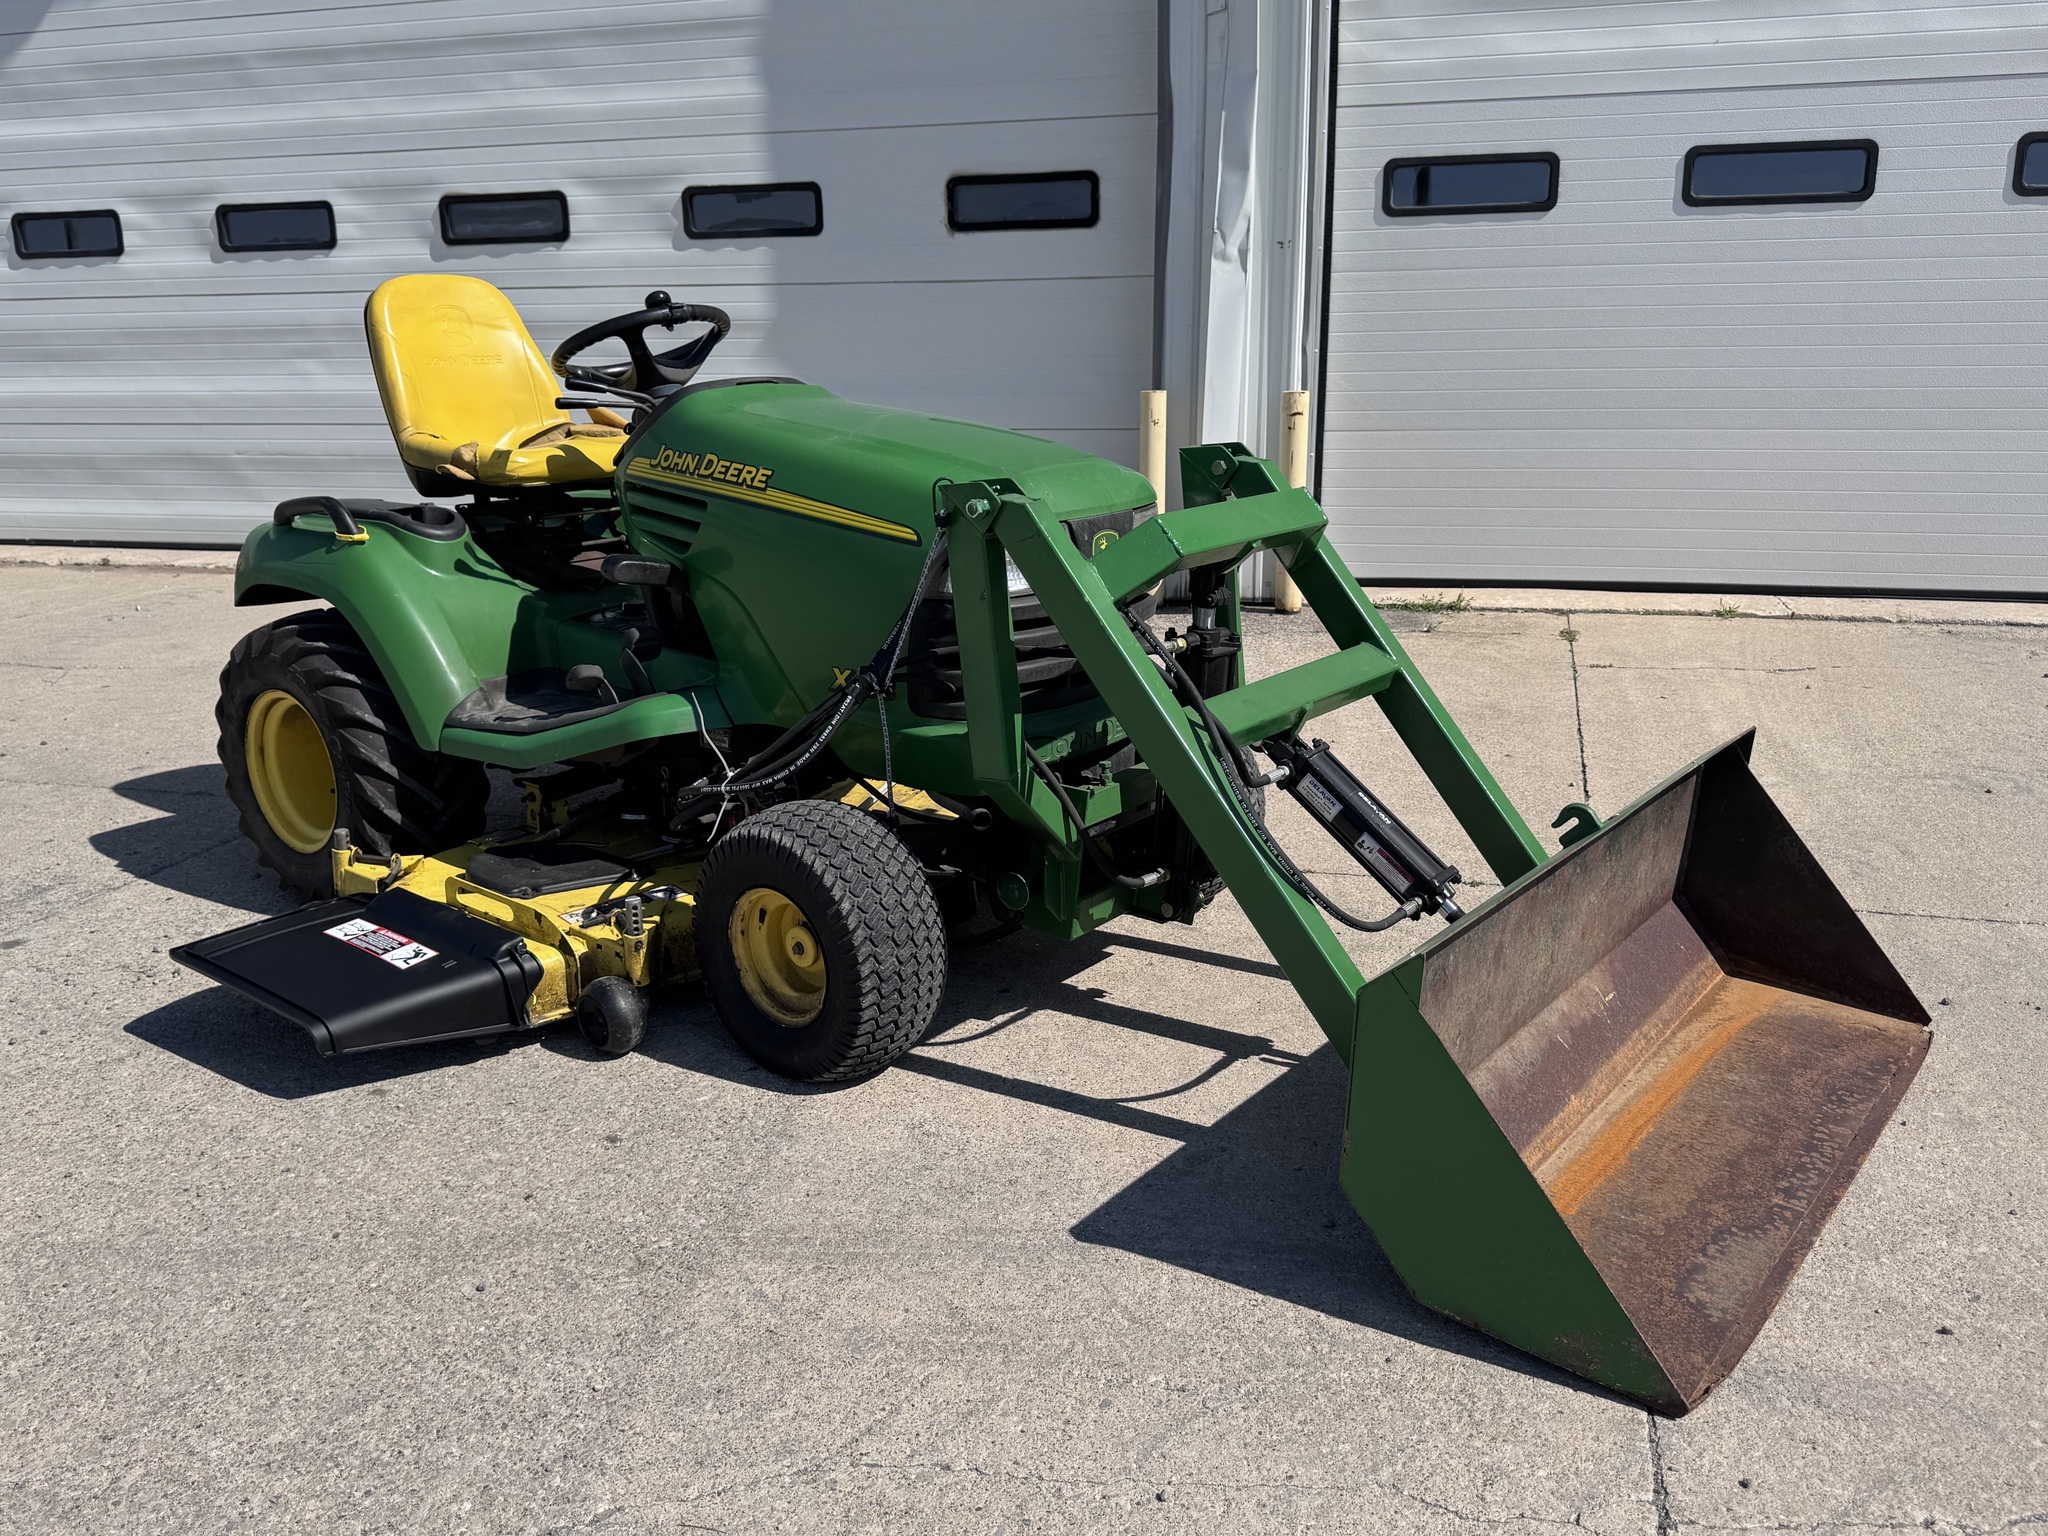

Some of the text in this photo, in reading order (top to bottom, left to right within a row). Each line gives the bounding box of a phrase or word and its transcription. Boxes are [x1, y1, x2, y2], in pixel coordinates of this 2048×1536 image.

[428, 353, 504, 367] JOHN DEERE
[650, 444, 773, 489] JOHN DEERE
[796, 752, 811, 767] MADE
[773, 769, 790, 781] CHINA
[1309, 780, 1337, 807] DELAVAN
[1357, 791, 1392, 825] DELAVAN
[1267, 841, 1278, 855] MAX
[1278, 855, 1294, 875] CHINA
[1293, 874, 1301, 883] IN
[1300, 881, 1316, 898] MADE
